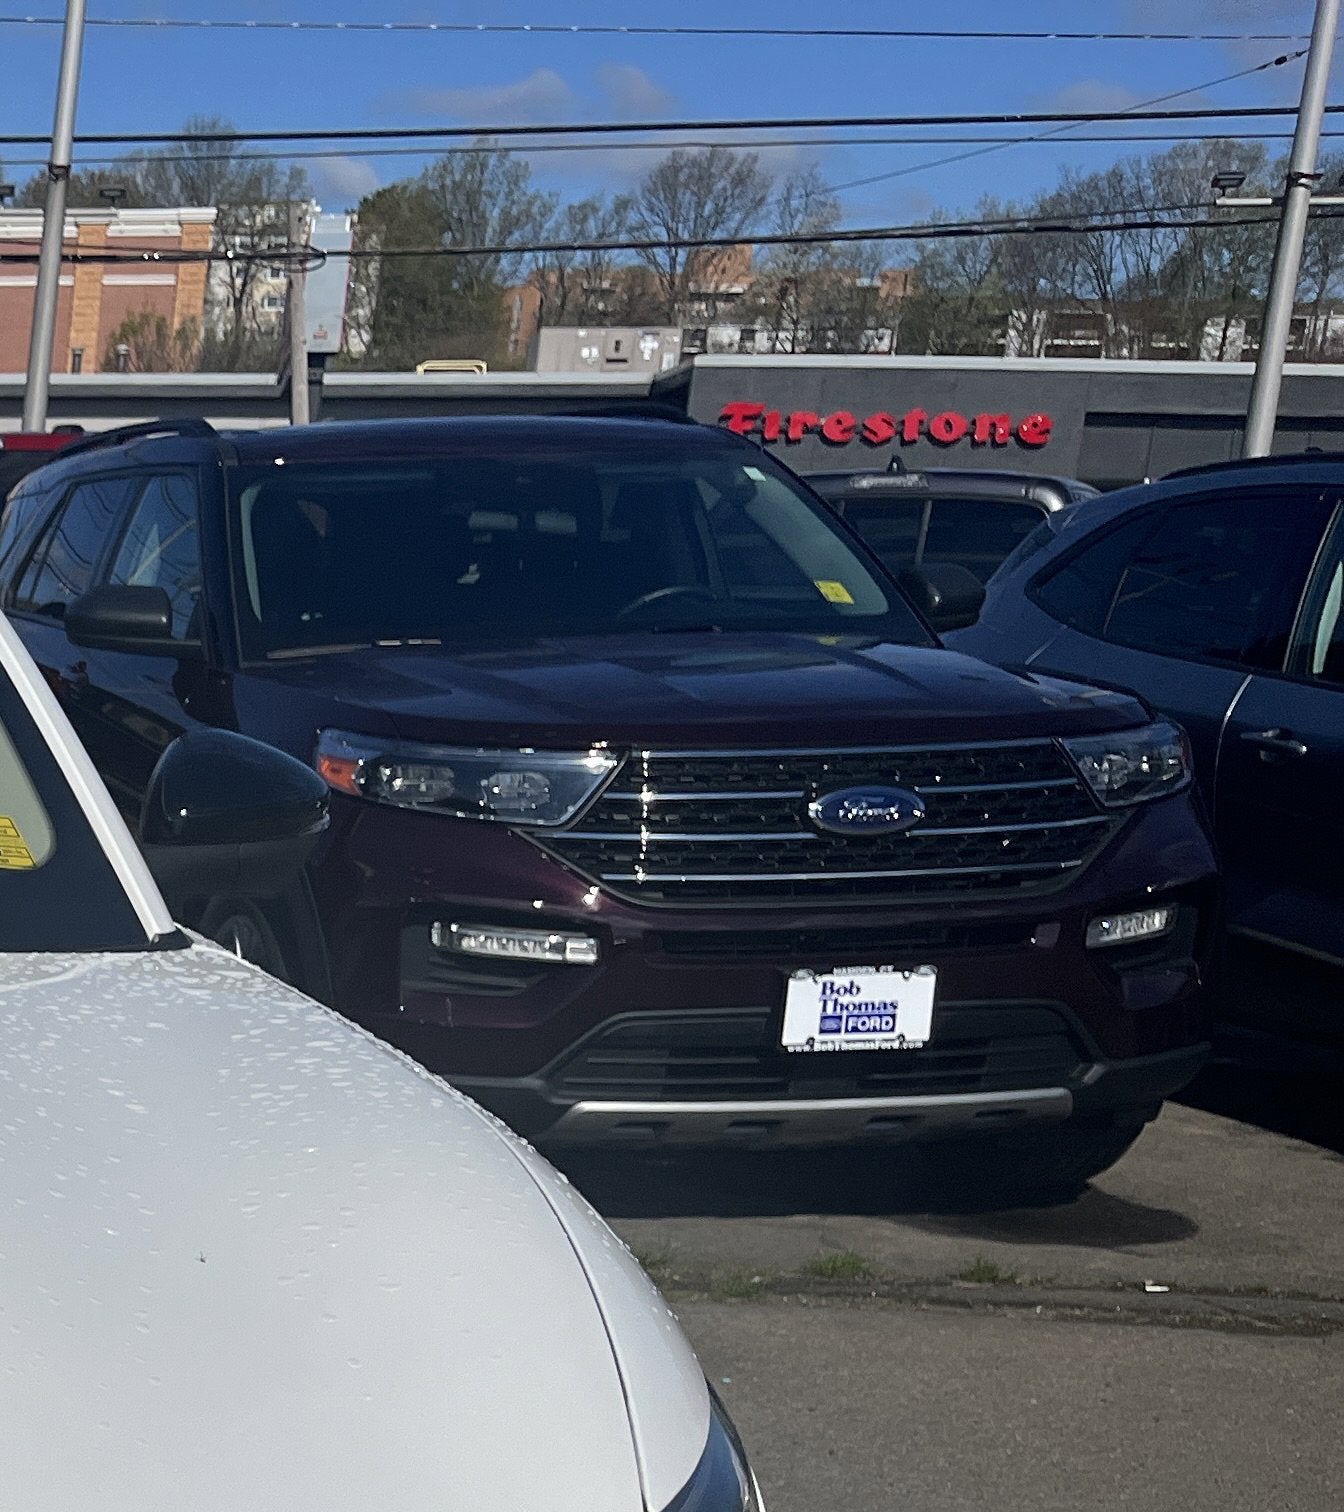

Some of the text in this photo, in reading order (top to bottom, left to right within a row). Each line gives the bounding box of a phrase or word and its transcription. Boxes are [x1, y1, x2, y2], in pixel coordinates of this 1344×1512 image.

[720, 401, 1054, 446] Firestone
[838, 796, 900, 822] Ford
[821, 980, 861, 996] Bob
[820, 997, 898, 1013] Thomas
[847, 1016, 894, 1032] FORD
